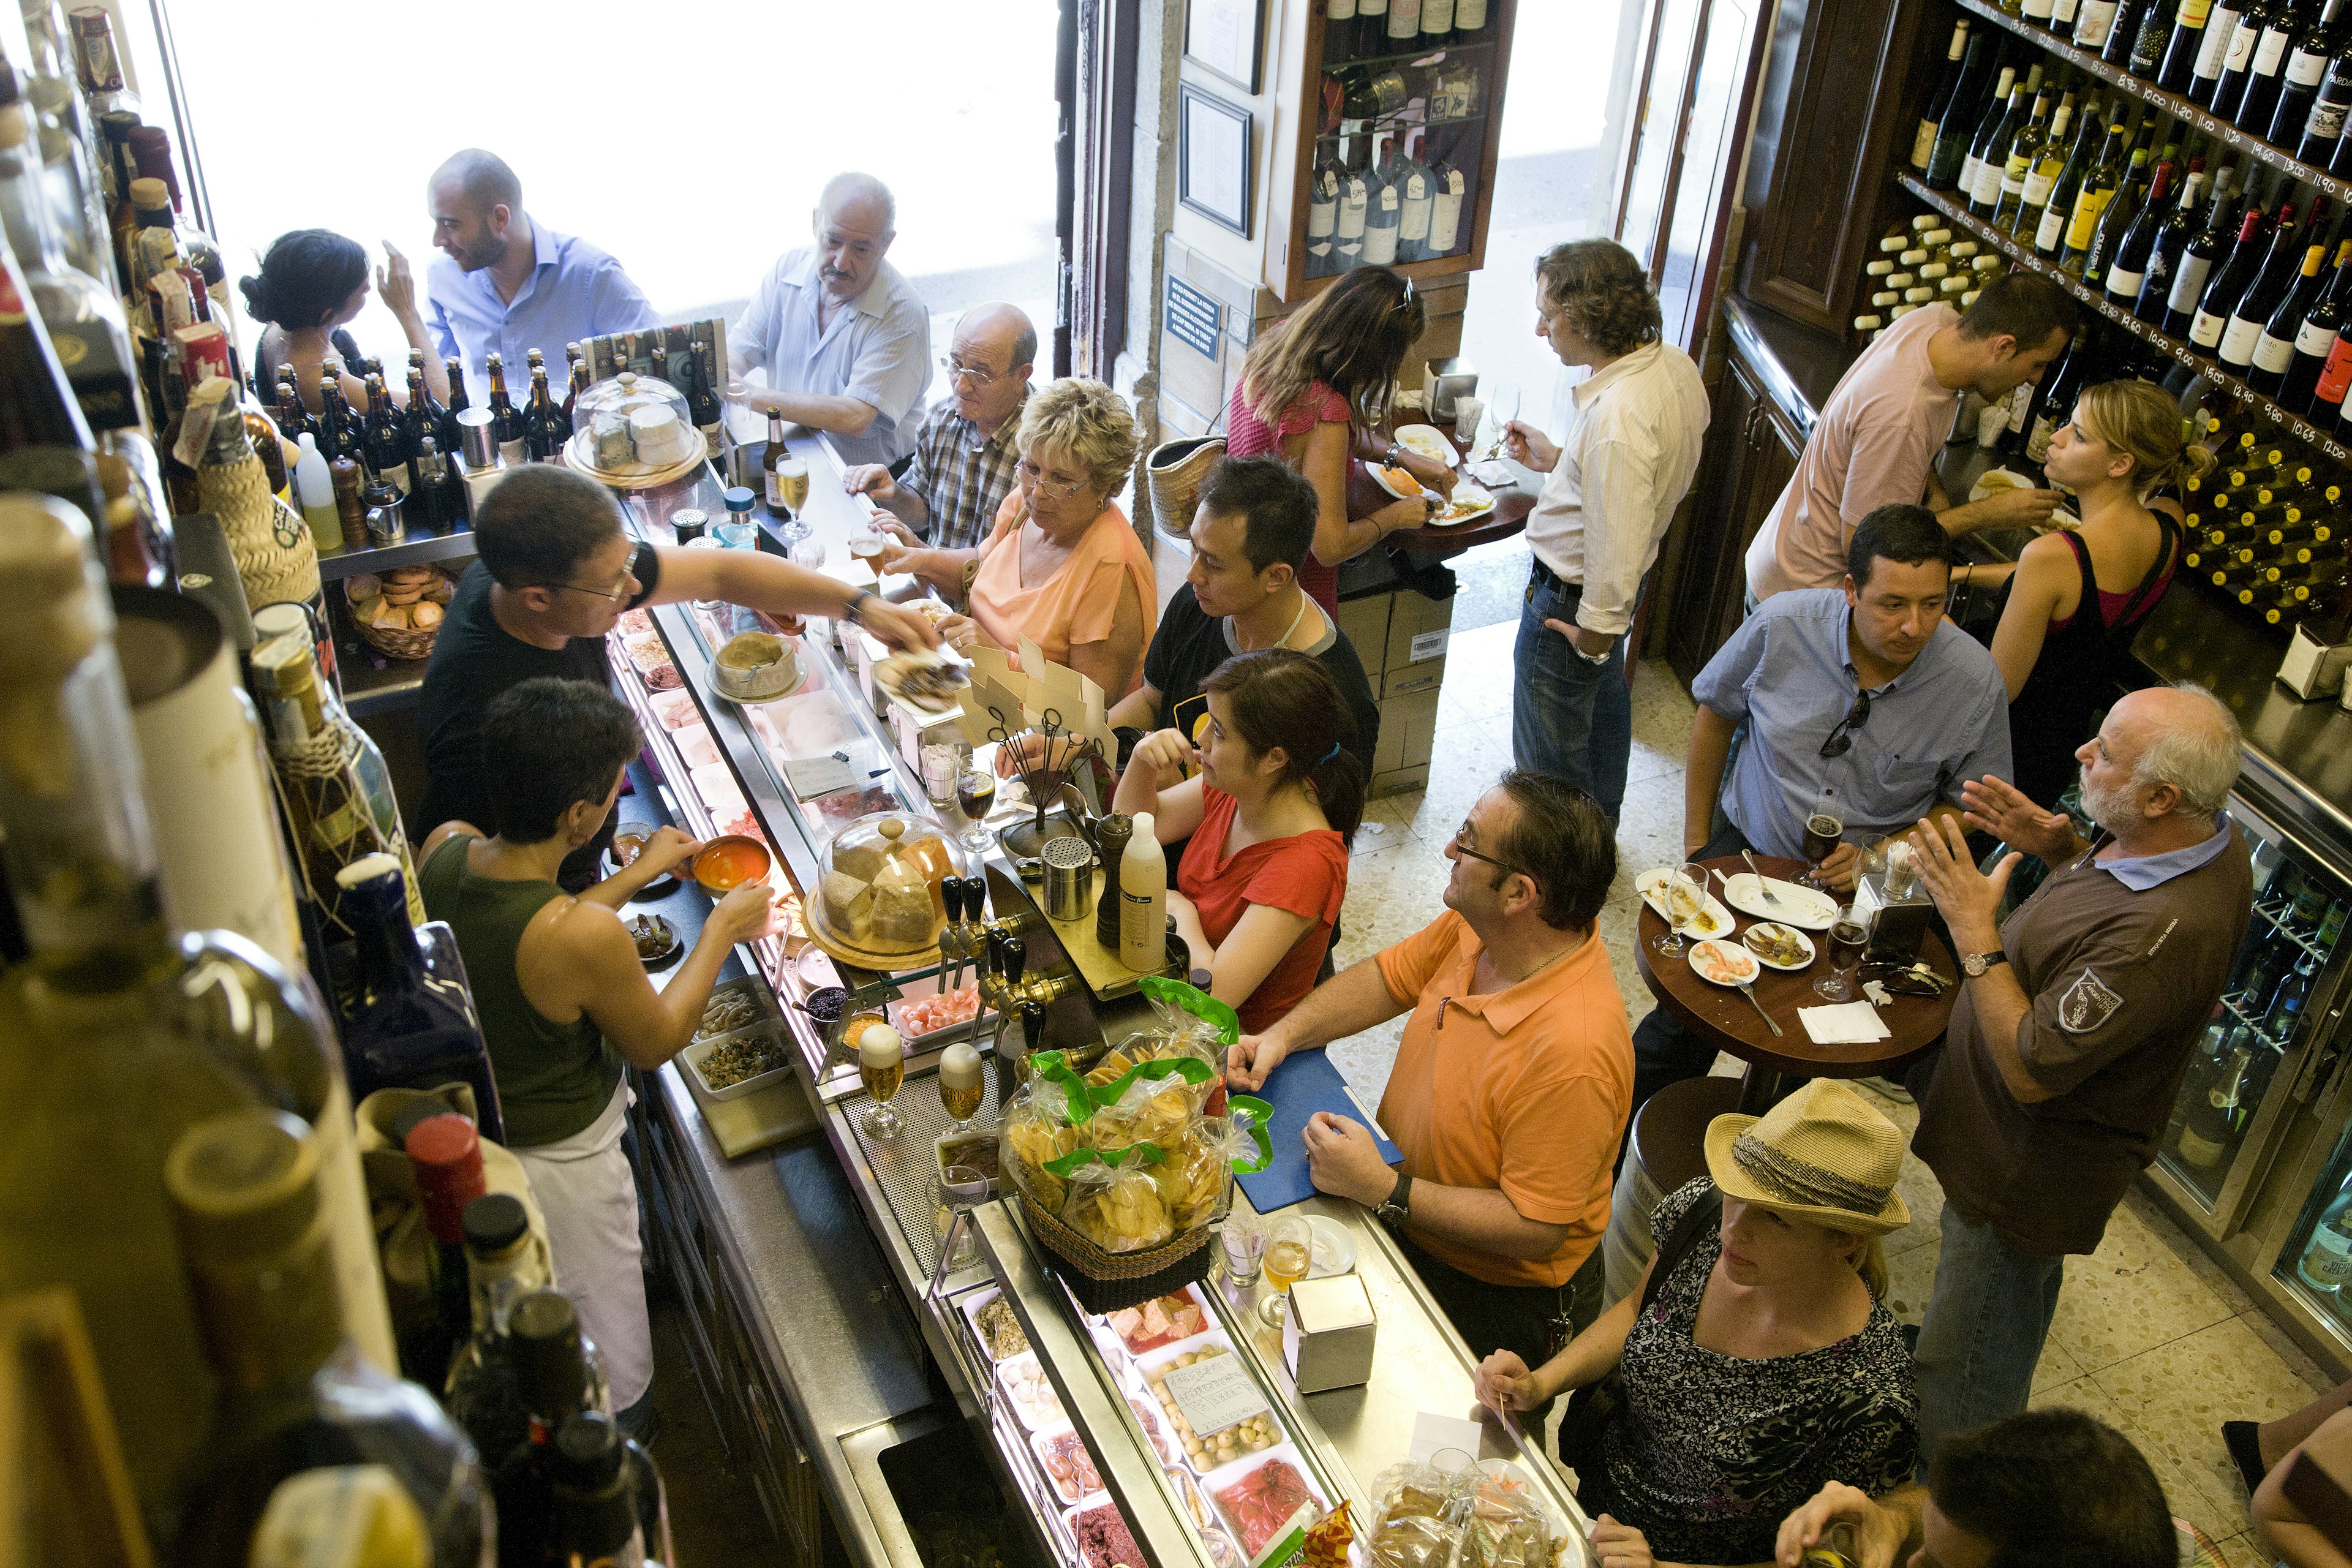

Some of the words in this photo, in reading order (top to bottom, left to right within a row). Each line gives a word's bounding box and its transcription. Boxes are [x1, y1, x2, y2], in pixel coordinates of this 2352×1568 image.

[2143, 87, 2166, 107] 10.00
[2170, 100, 2193, 120] 11.20
[2251, 141, 2275, 163] 19.60
[2282, 157, 2305, 178] 13.00
[2313, 173, 2336, 194] 11.90
[1172, 281, 1178, 291] NO
[1178, 285, 1183, 294] ES
[1183, 288, 1197, 303] PERMET
[1197, 298, 1202, 307] LA
[1202, 301, 1215, 314] VENDA
[1176, 294, 1181, 303] EL
[1168, 299, 1174, 308] DE
[1174, 303, 1190, 318] BEGUDES
[1172, 312, 1177, 320] DE
[1195, 327, 1199, 336] NI
[1199, 330, 1212, 344] TABAC
[2120, 313, 2141, 334] 19.60
[1175, 325, 1190, 340] MENORS
[1190, 334, 1196, 343] DE
[1199, 341, 1210, 353] ANYS
[2148, 330, 2168, 350] 10.00
[2175, 347, 2194, 367] 9.00
[2204, 364, 2225, 385] 15.00
[2233, 383, 2254, 404] 12.90
[2264, 403, 2283, 423] 9.80
[2291, 420, 2316, 443] 10.65
[2323, 439, 2346, 459] 12.00
[2148, 934, 2168, 956] ETIQUETA
[2165, 919, 2179, 934] NEGRA
[2086, 985, 2113, 1009] ARGENTINO
[2101, 992, 2117, 1005] POLO
